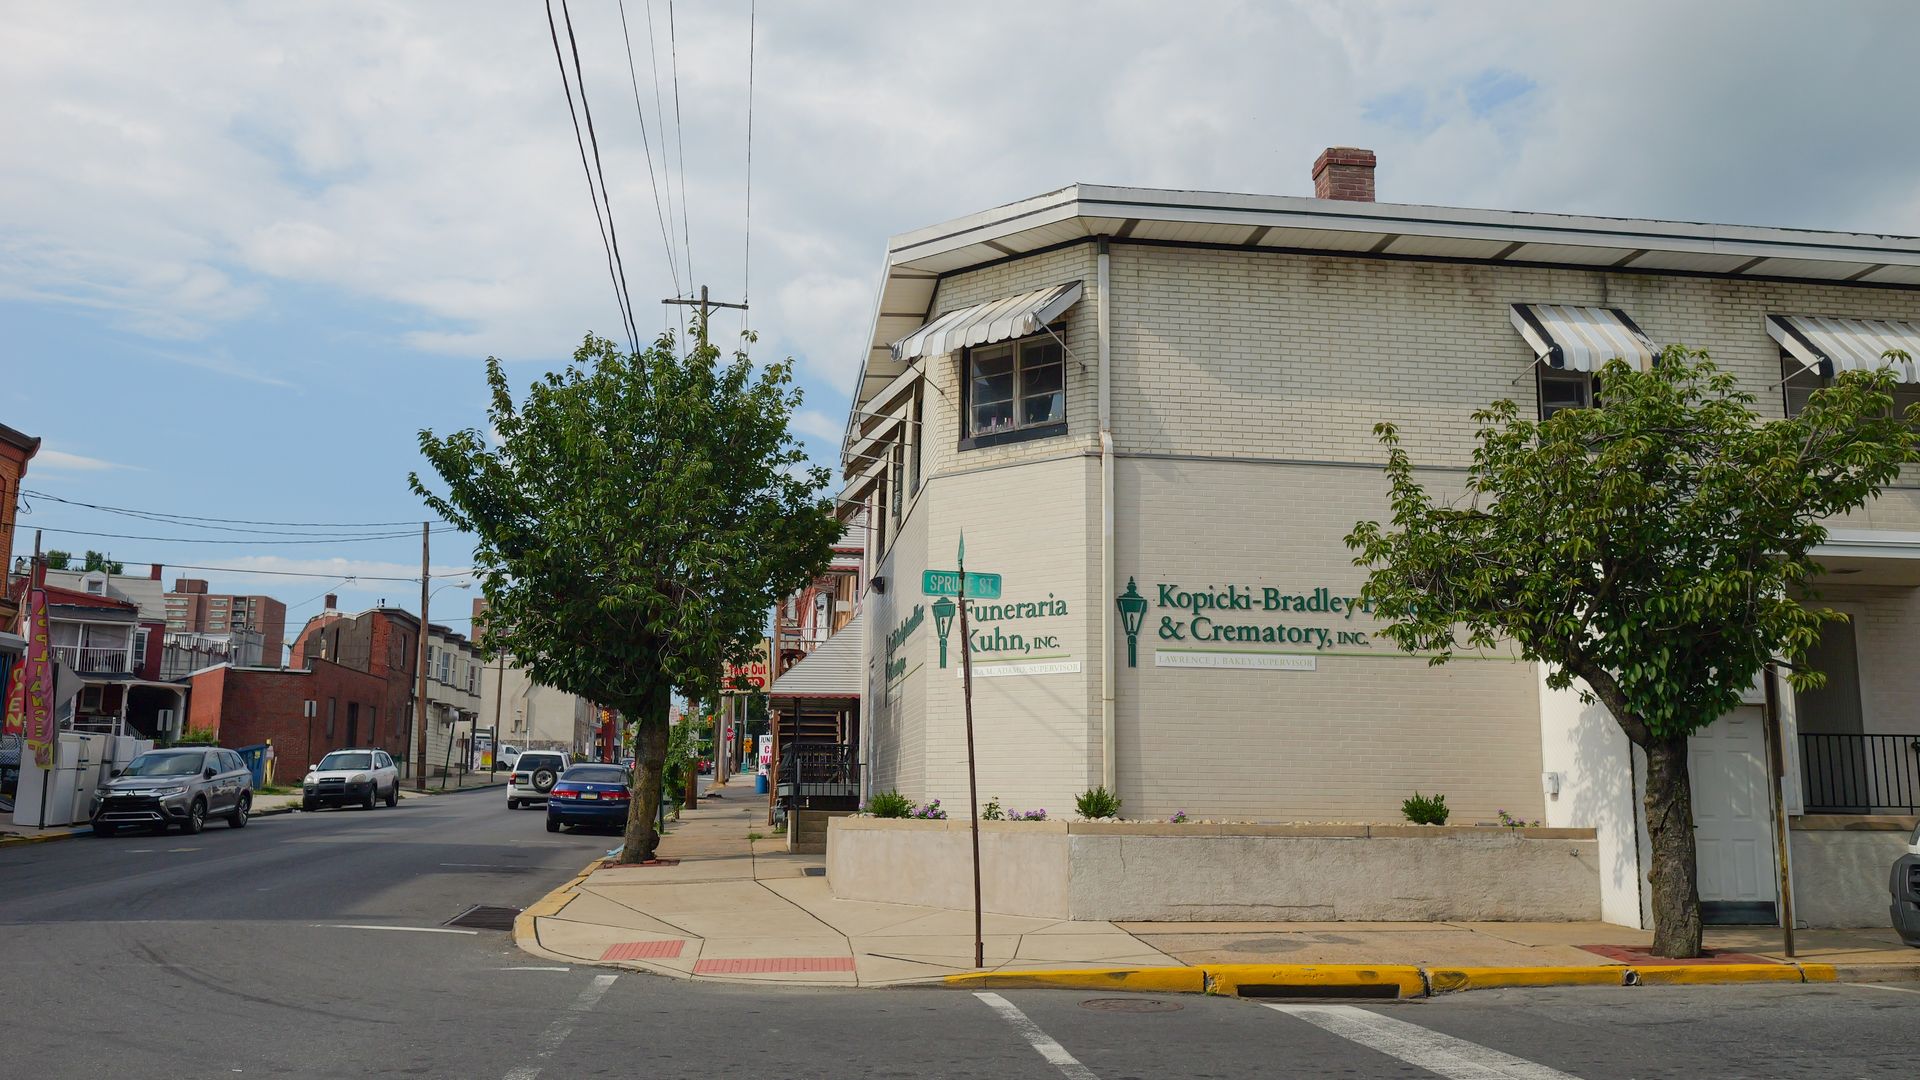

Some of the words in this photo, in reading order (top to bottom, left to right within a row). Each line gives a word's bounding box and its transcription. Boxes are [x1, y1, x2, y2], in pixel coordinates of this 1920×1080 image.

[930, 574, 973, 593] SPRUE
[979, 577, 993, 594] ST
[1157, 584, 1357, 619] Kopicki-Bradley
[1158, 616, 1185, 640] &
[1190, 617, 1333, 650] Crematory,
[1337, 631, 1370, 645] INC.
[1033, 636, 1060, 649] INC.
[751, 663, 766, 675] Out
[1028, 662, 1080, 673] SUPERVISOR
[1159, 655, 1209, 664] LAWRENCE
[1257, 658, 1313, 668] SUPERVISOR
[6, 668, 24, 727] OPEN
